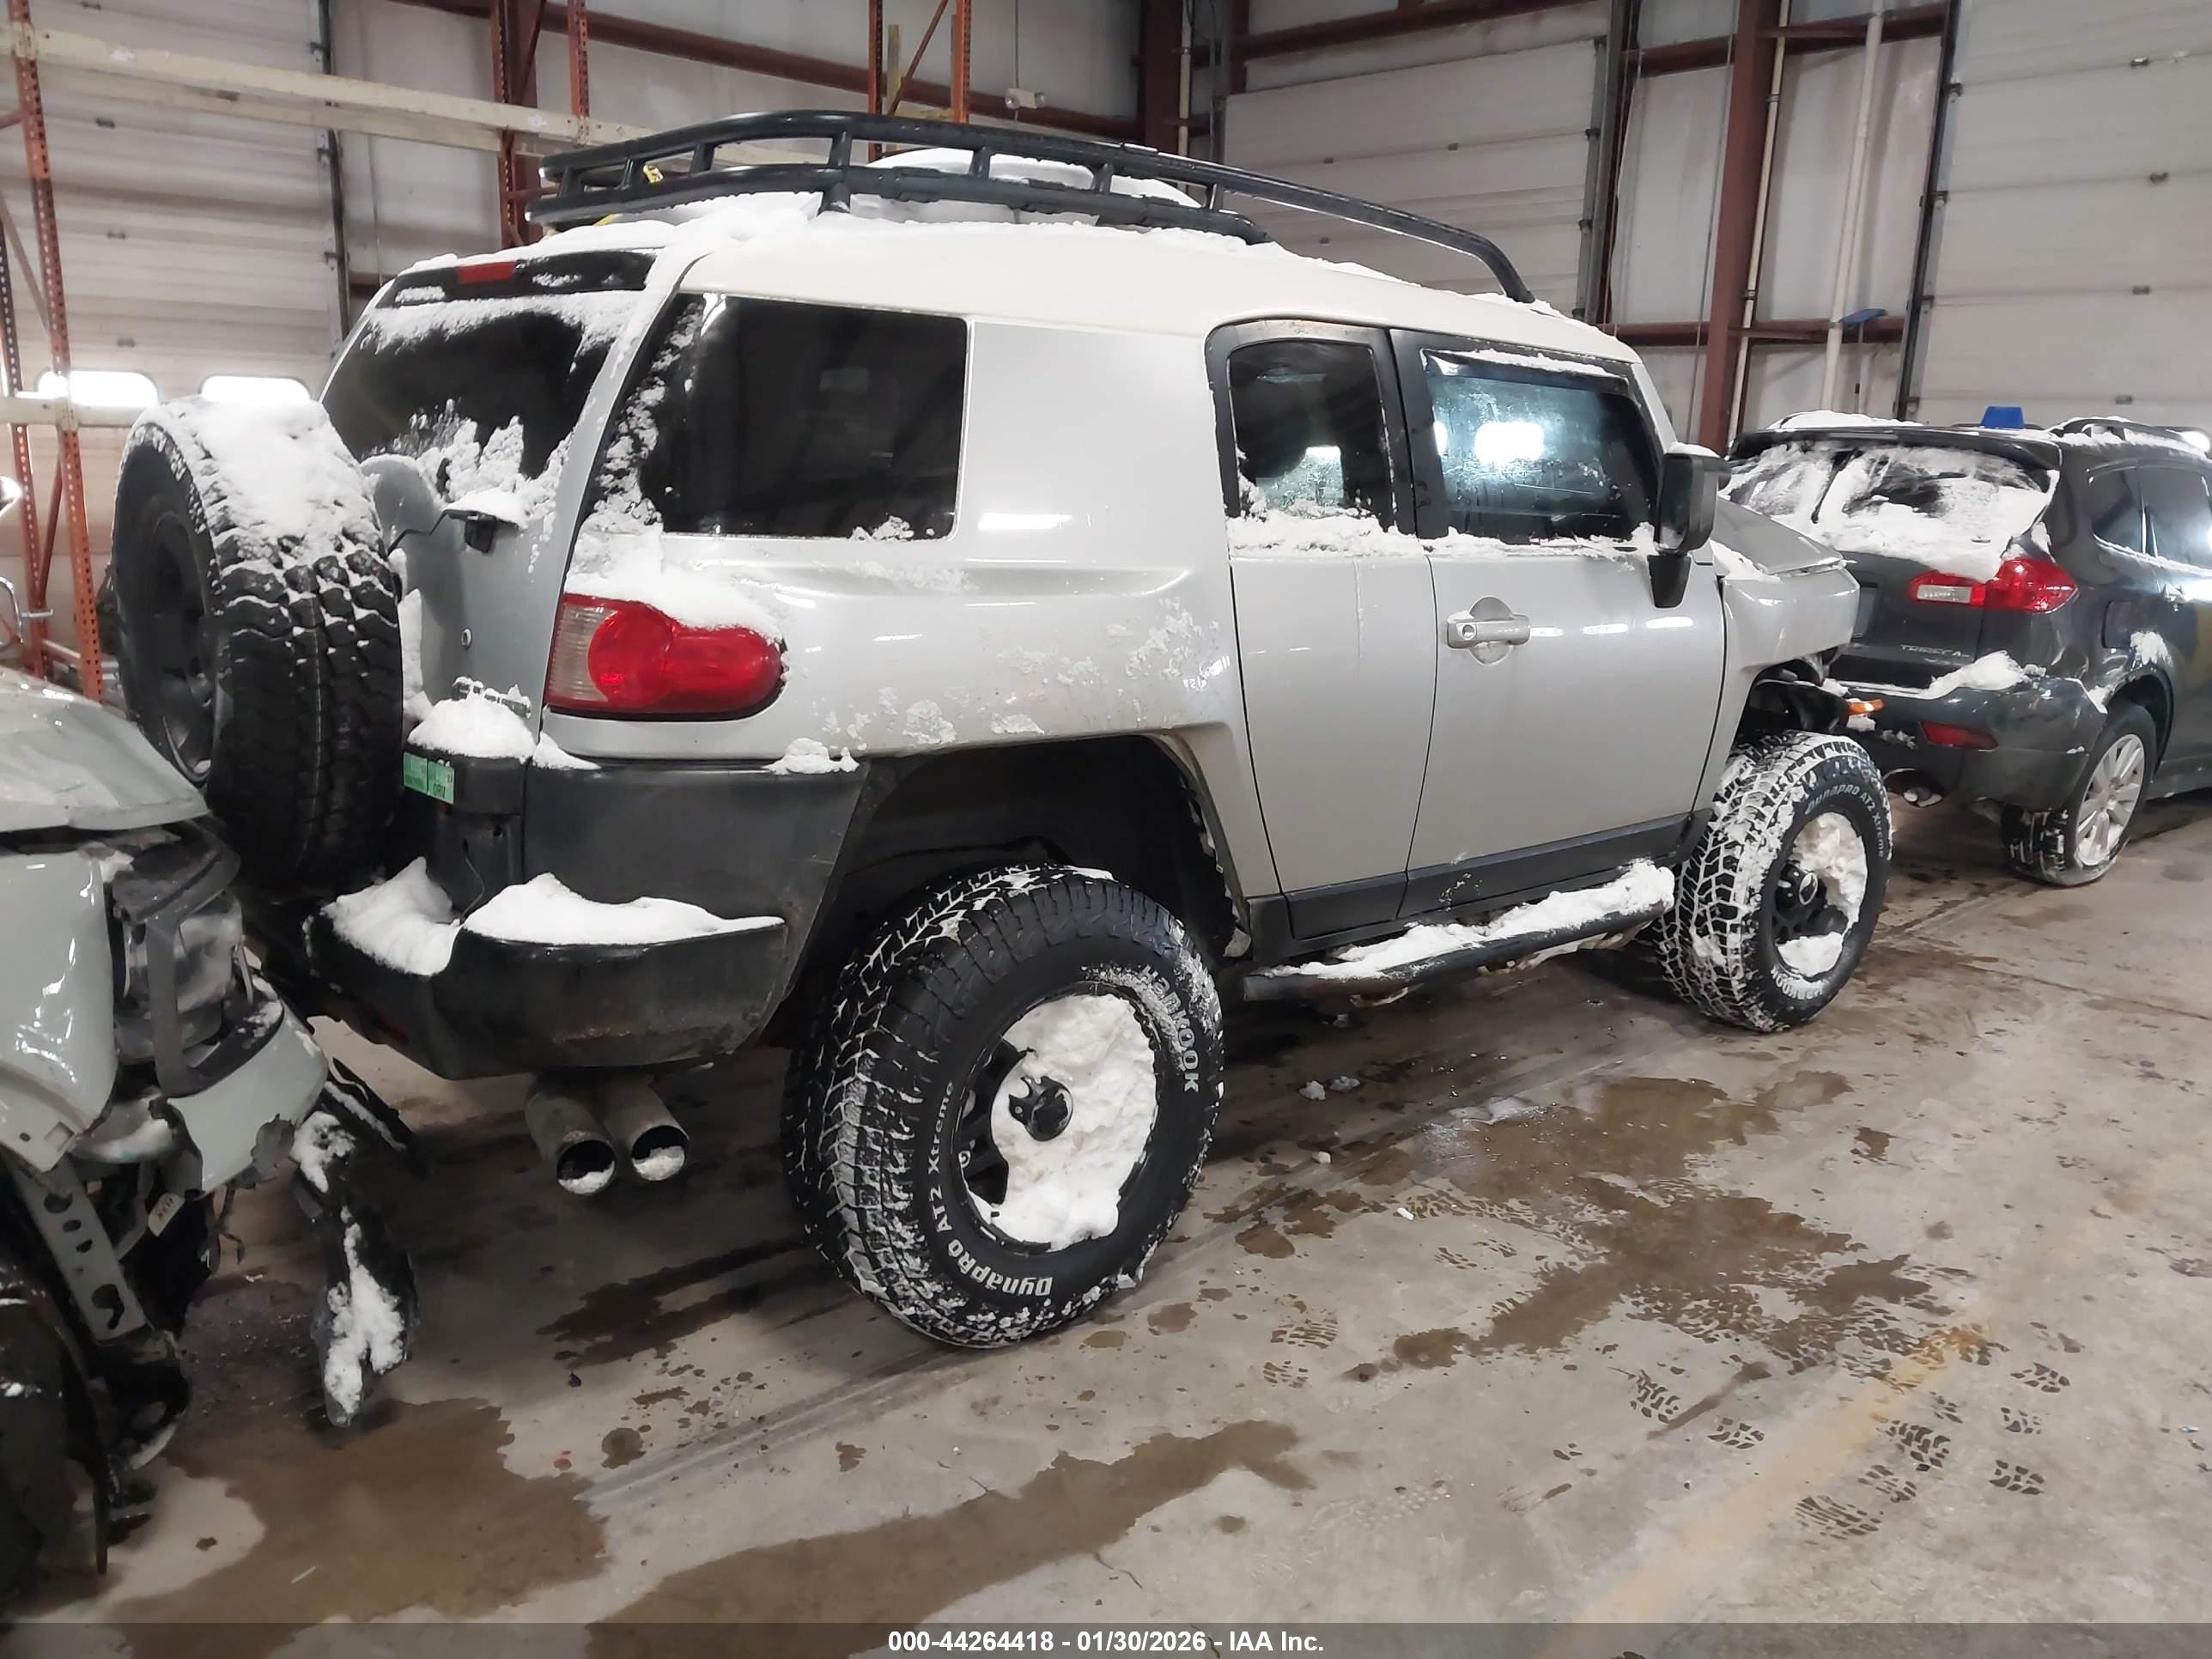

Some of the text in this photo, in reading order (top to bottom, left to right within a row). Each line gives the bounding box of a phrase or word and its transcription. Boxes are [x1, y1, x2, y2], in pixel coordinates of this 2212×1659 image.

[1900, 644, 1961, 656] TRIBECA
[1859, 792, 1876, 811] AT2
[1873, 812, 1884, 858] Xtreme
[927, 1081, 953, 1175] Xtreme
[929, 1185, 952, 1233] AT2
